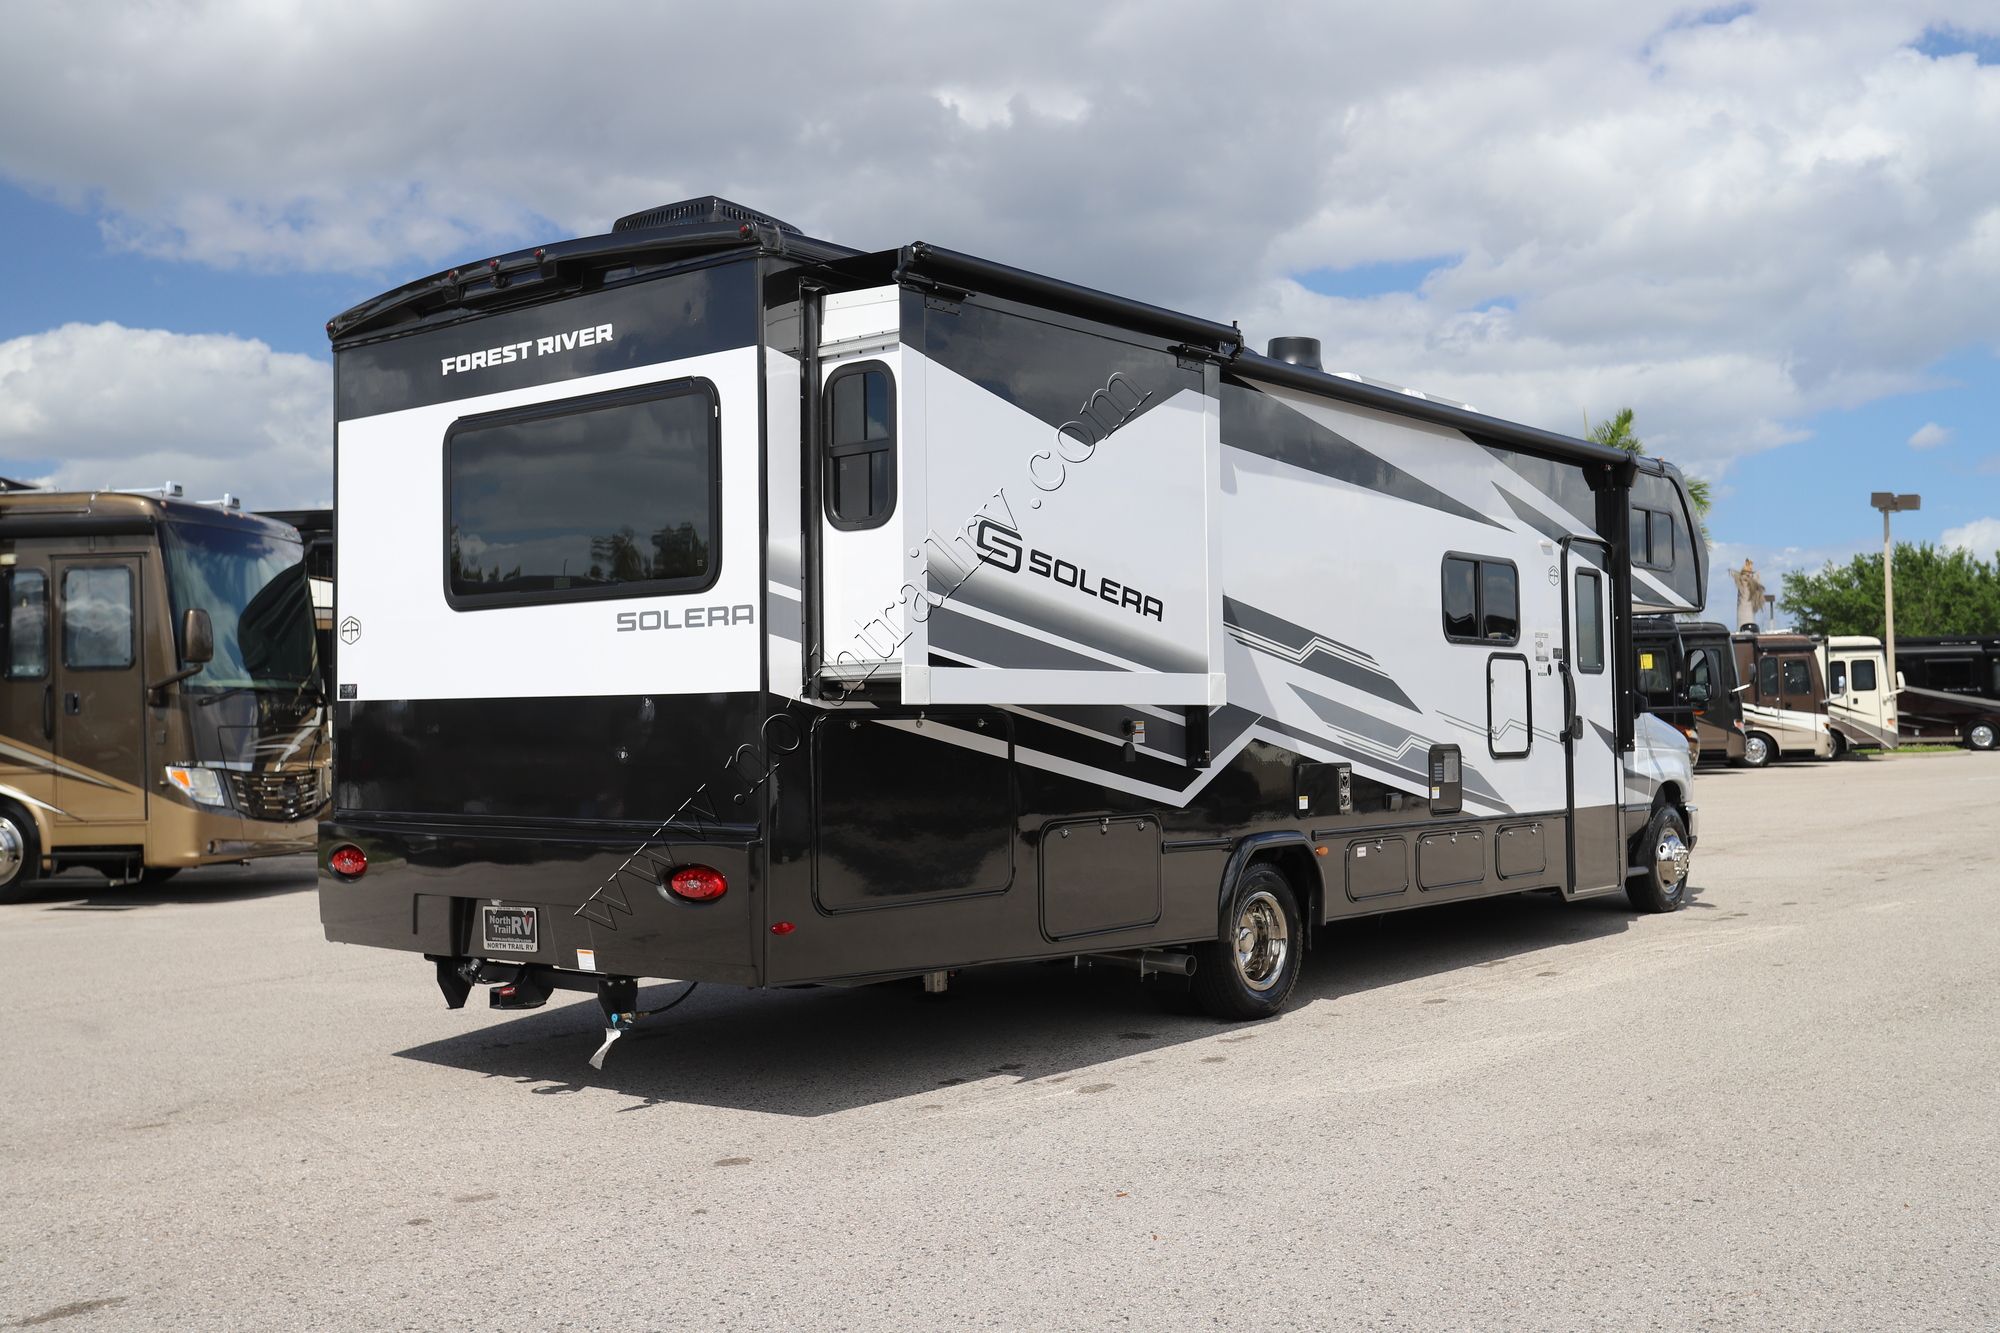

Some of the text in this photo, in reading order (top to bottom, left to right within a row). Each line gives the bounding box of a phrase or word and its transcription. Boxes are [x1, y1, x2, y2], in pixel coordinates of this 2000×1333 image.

[441, 323, 613, 376] FOREST RIVER
[1028, 549, 1164, 623] SOLERA
[616, 604, 754, 632] SOLERA
[489, 915, 511, 925] North
[493, 924, 511, 934] Trail
[511, 916, 533, 935] RV
[487, 942, 507, 950] NORTH
